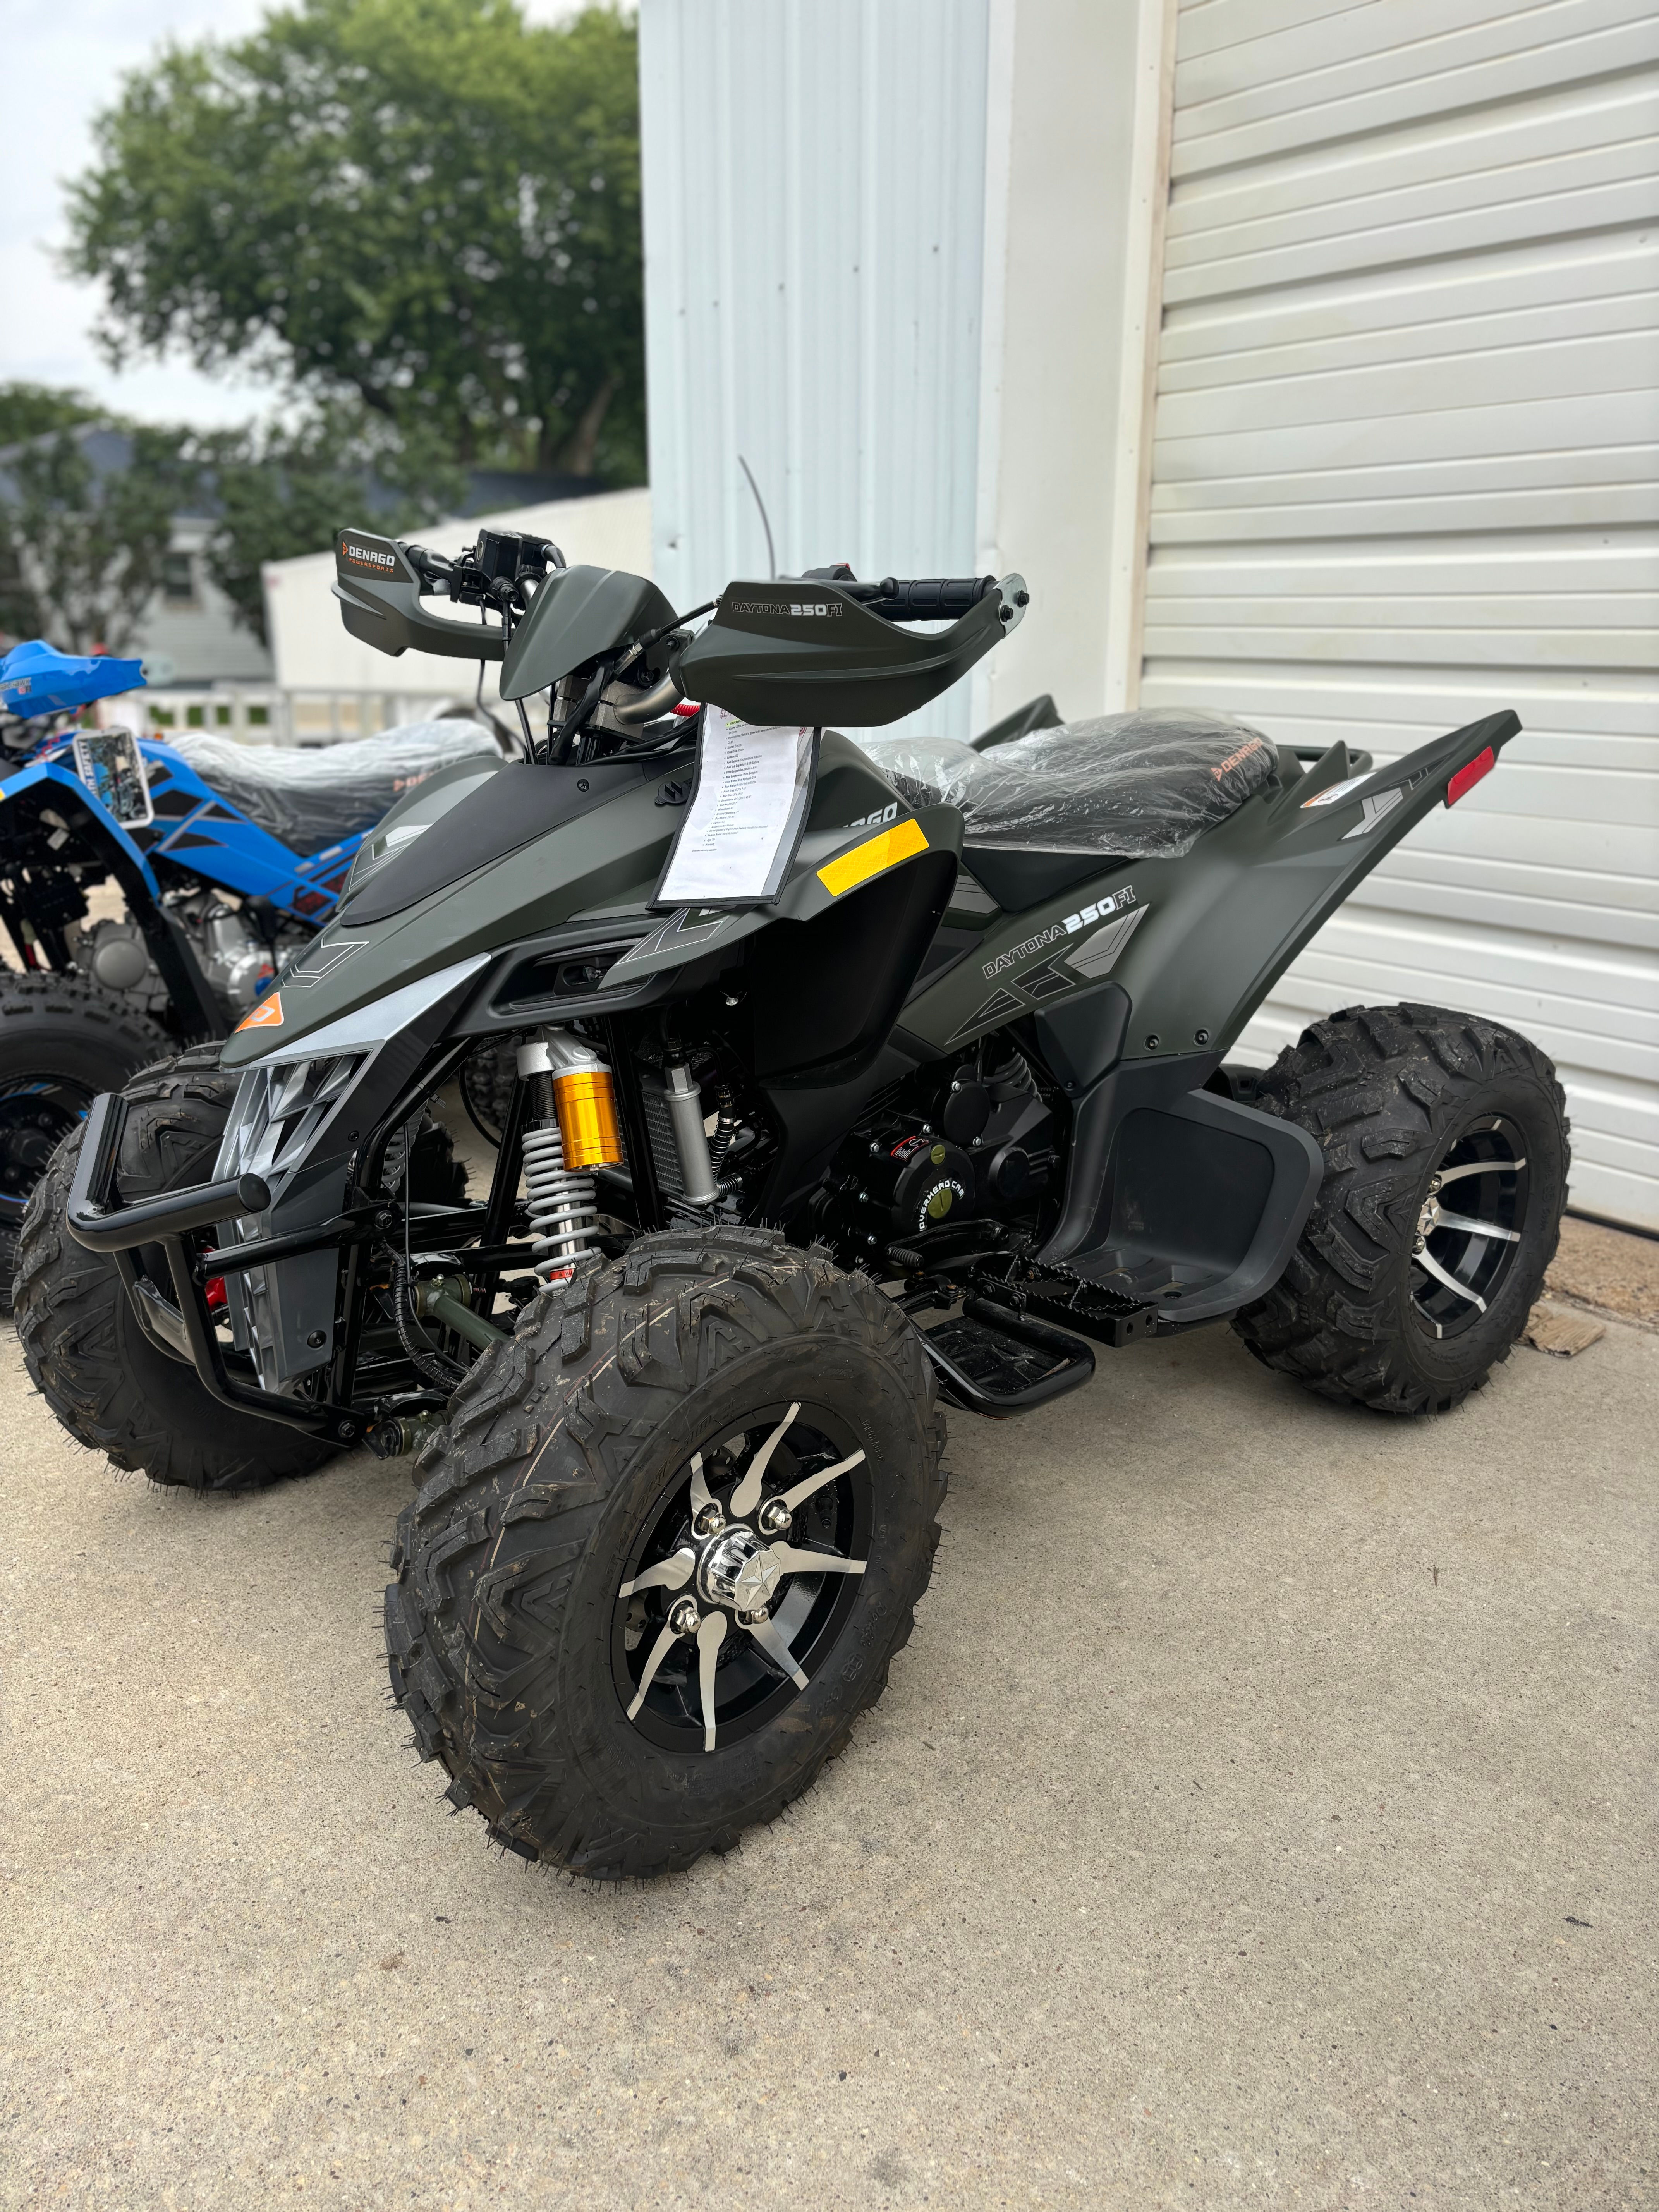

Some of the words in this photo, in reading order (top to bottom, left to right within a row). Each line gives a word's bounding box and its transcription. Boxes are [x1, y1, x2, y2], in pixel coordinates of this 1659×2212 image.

[349, 546, 395, 567] DENAGO
[349, 558, 394, 573] POWERSPORTS
[919, 1180, 950, 1229] OVERHEAD
[951, 1181, 964, 1197] CAM
